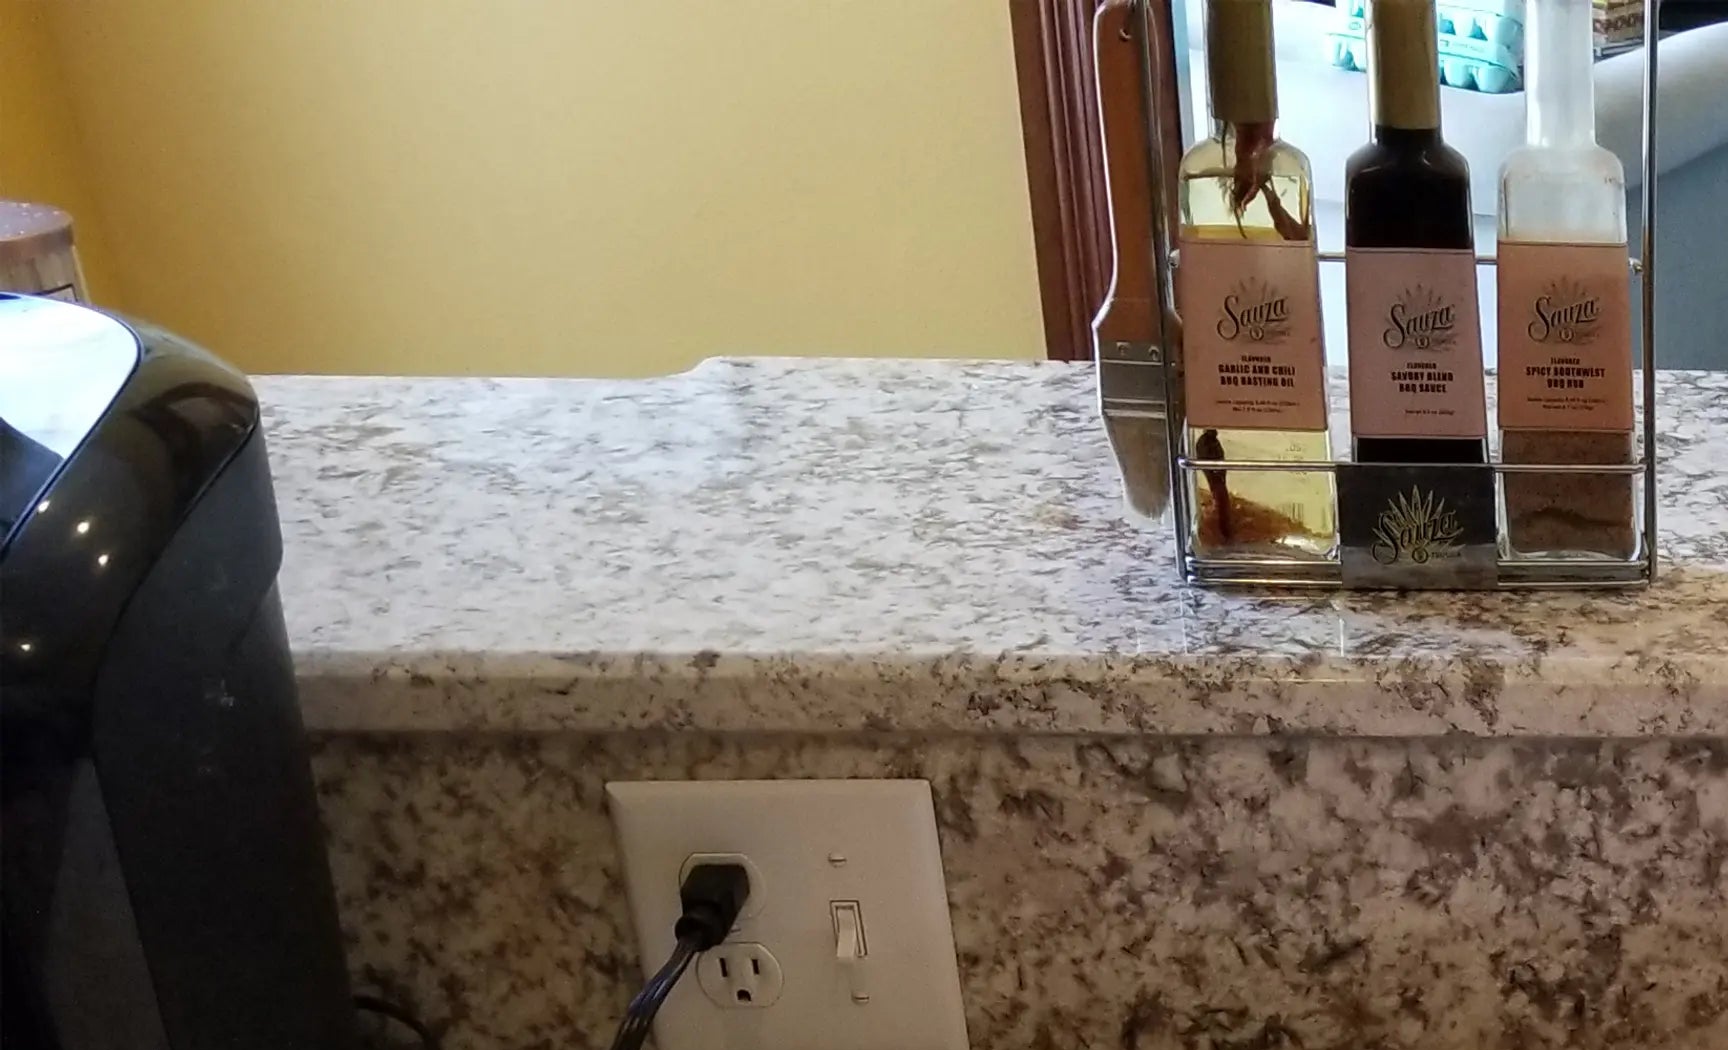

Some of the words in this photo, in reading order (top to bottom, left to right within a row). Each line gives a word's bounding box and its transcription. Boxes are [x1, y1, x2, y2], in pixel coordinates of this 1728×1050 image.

[1217, 295, 1288, 340] Sauza
[1528, 296, 1599, 341] Sauza
[1383, 304, 1454, 349] Sauza
[1218, 364, 1250, 373] GARLIC
[1252, 365, 1270, 374] AND
[1272, 366, 1295, 376] CHILI
[1526, 366, 1551, 376] SPICY
[1553, 367, 1606, 377] SOUTHWEST
[1220, 376, 1239, 386] BBQ
[1241, 376, 1279, 387] BASTING
[1281, 377, 1295, 387] OIL
[1391, 371, 1424, 381] SAVORY
[1427, 372, 1454, 381] BLEND
[1399, 383, 1417, 393] BBQ
[1419, 383, 1446, 393] SAUCE
[1547, 378, 1565, 389] BBQ
[1567, 379, 1584, 388] RUB
[1371, 511, 1463, 565] Sauza
